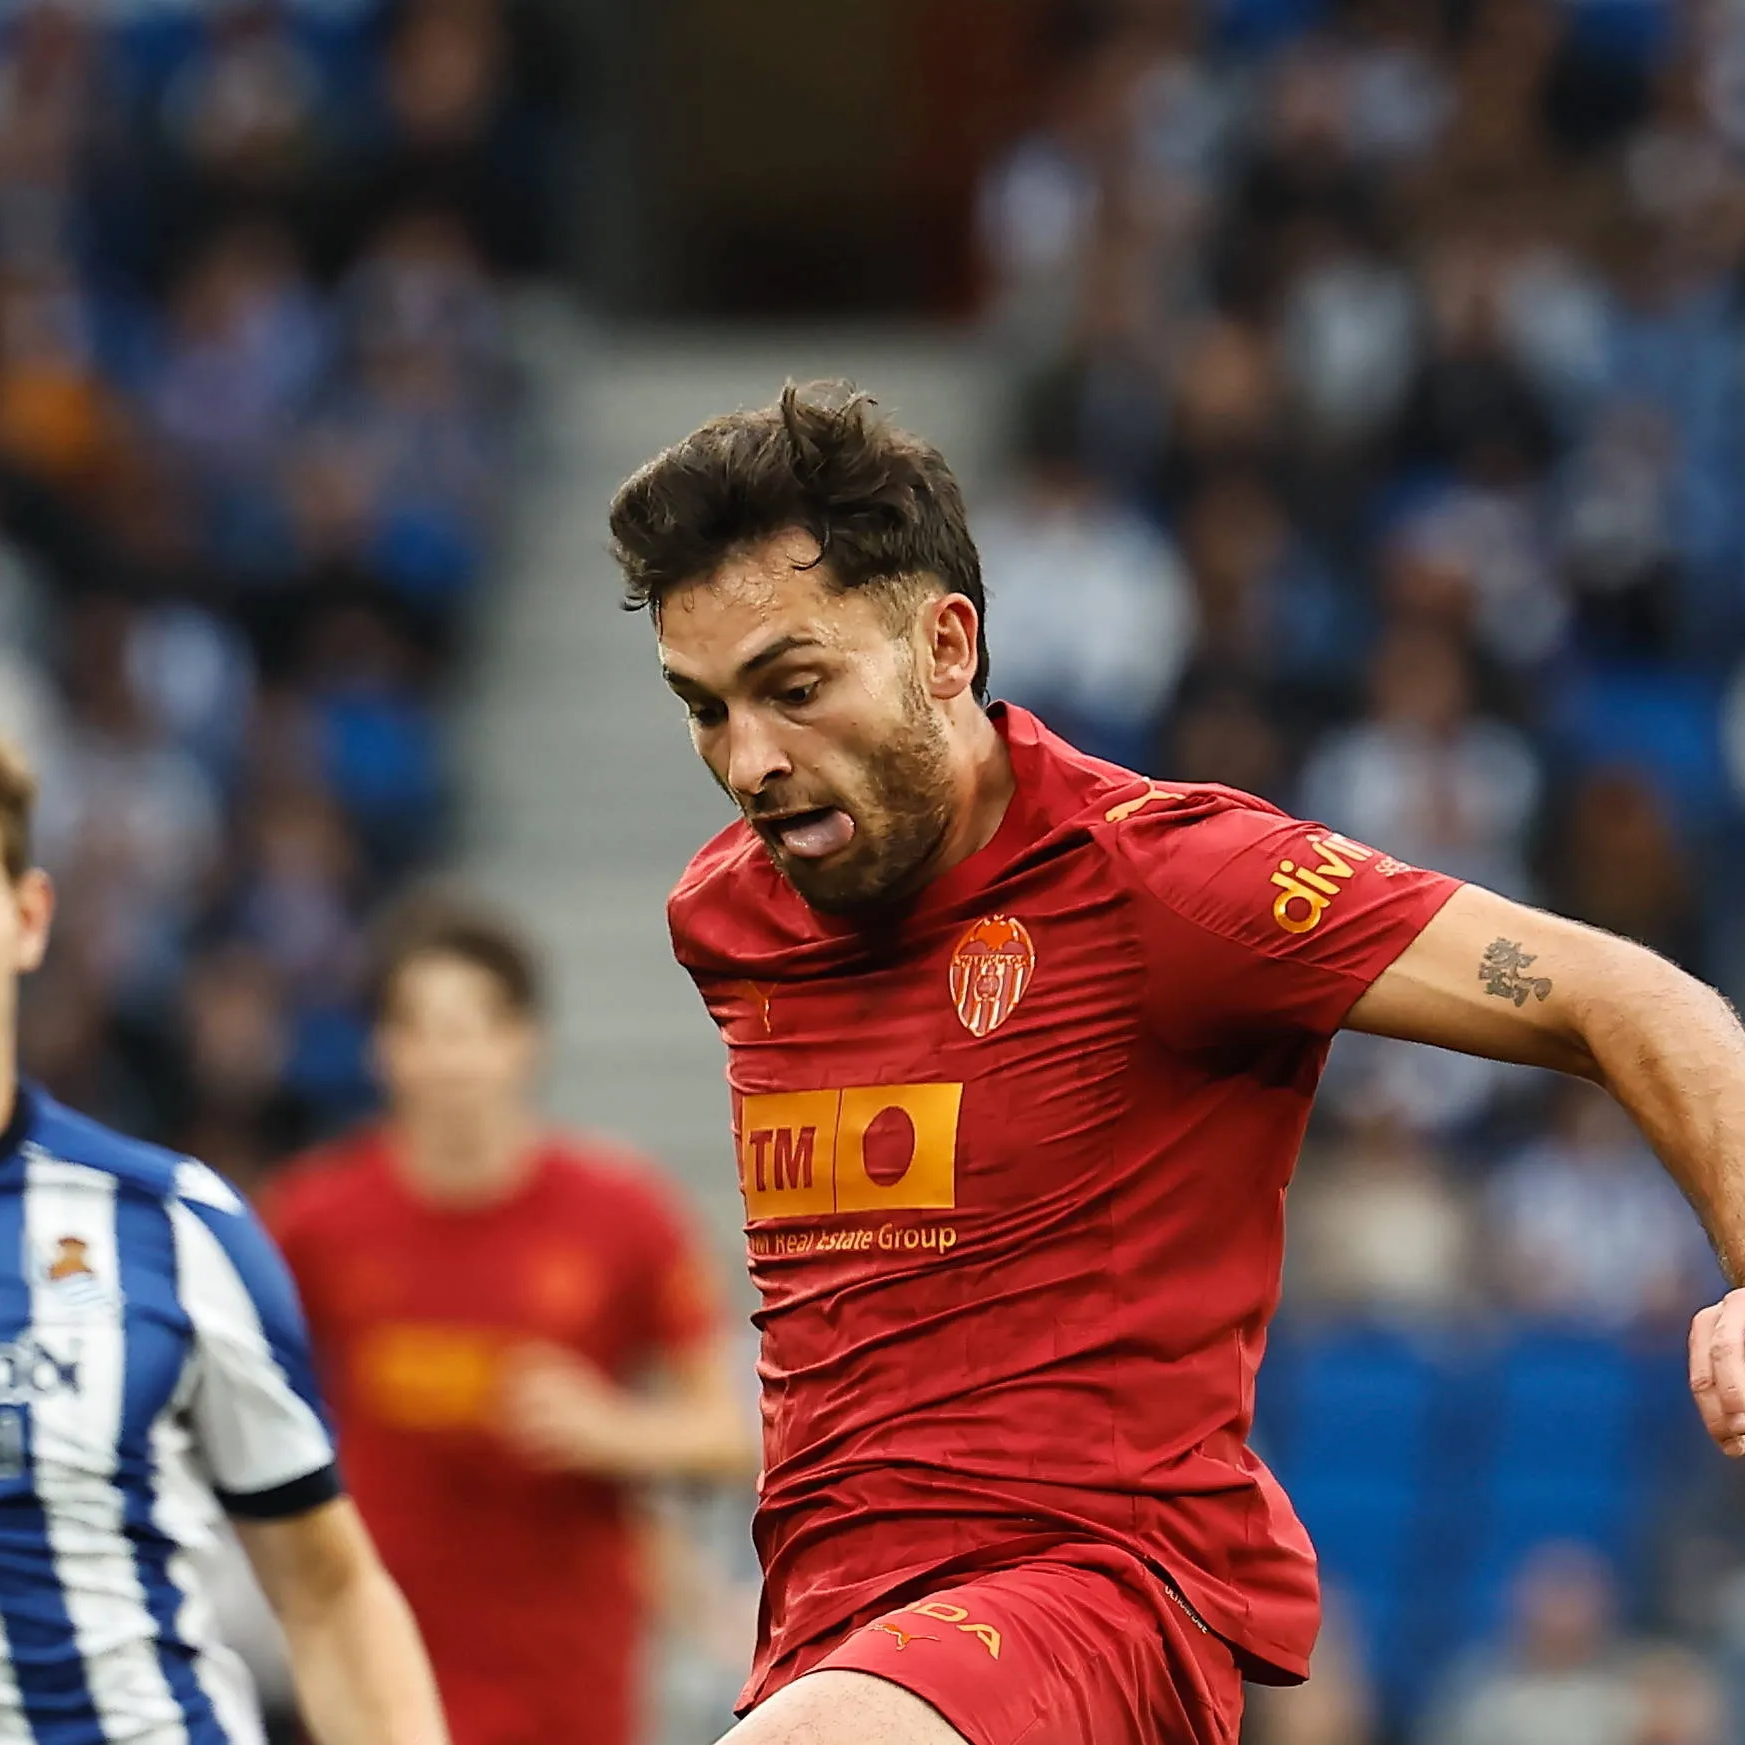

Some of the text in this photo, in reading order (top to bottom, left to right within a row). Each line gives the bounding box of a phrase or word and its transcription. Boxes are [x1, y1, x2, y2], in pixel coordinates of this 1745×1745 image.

[749, 1125, 817, 1192] TM
[775, 1230, 815, 1254] Real
[815, 1227, 874, 1251] Estate
[877, 1222, 958, 1254] Group
